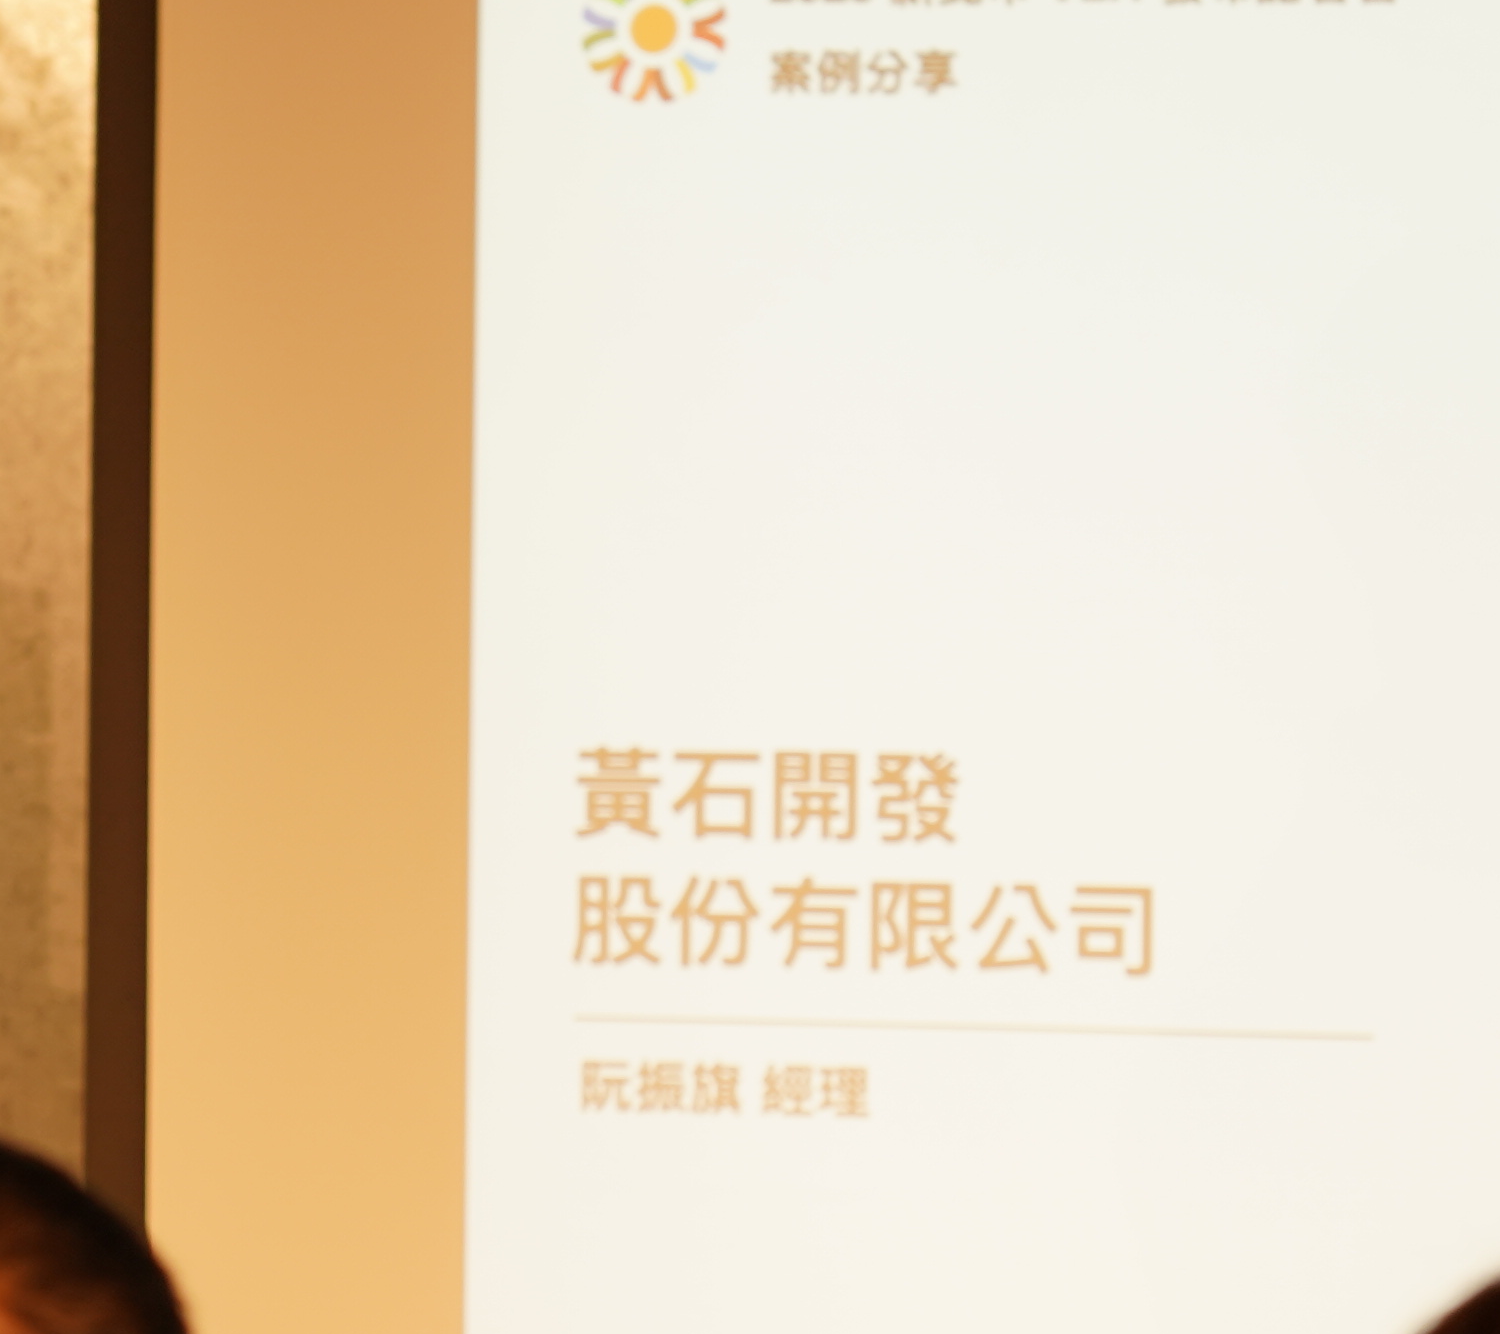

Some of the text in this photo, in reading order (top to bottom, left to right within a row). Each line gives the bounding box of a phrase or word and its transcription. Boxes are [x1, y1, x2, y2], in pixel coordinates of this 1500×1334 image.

[769, 49, 958, 95] 案例分享
[575, 746, 960, 843] 黃石開發
[573, 875, 1157, 977] 股份有限公司
[763, 1064, 869, 1117] 經理
